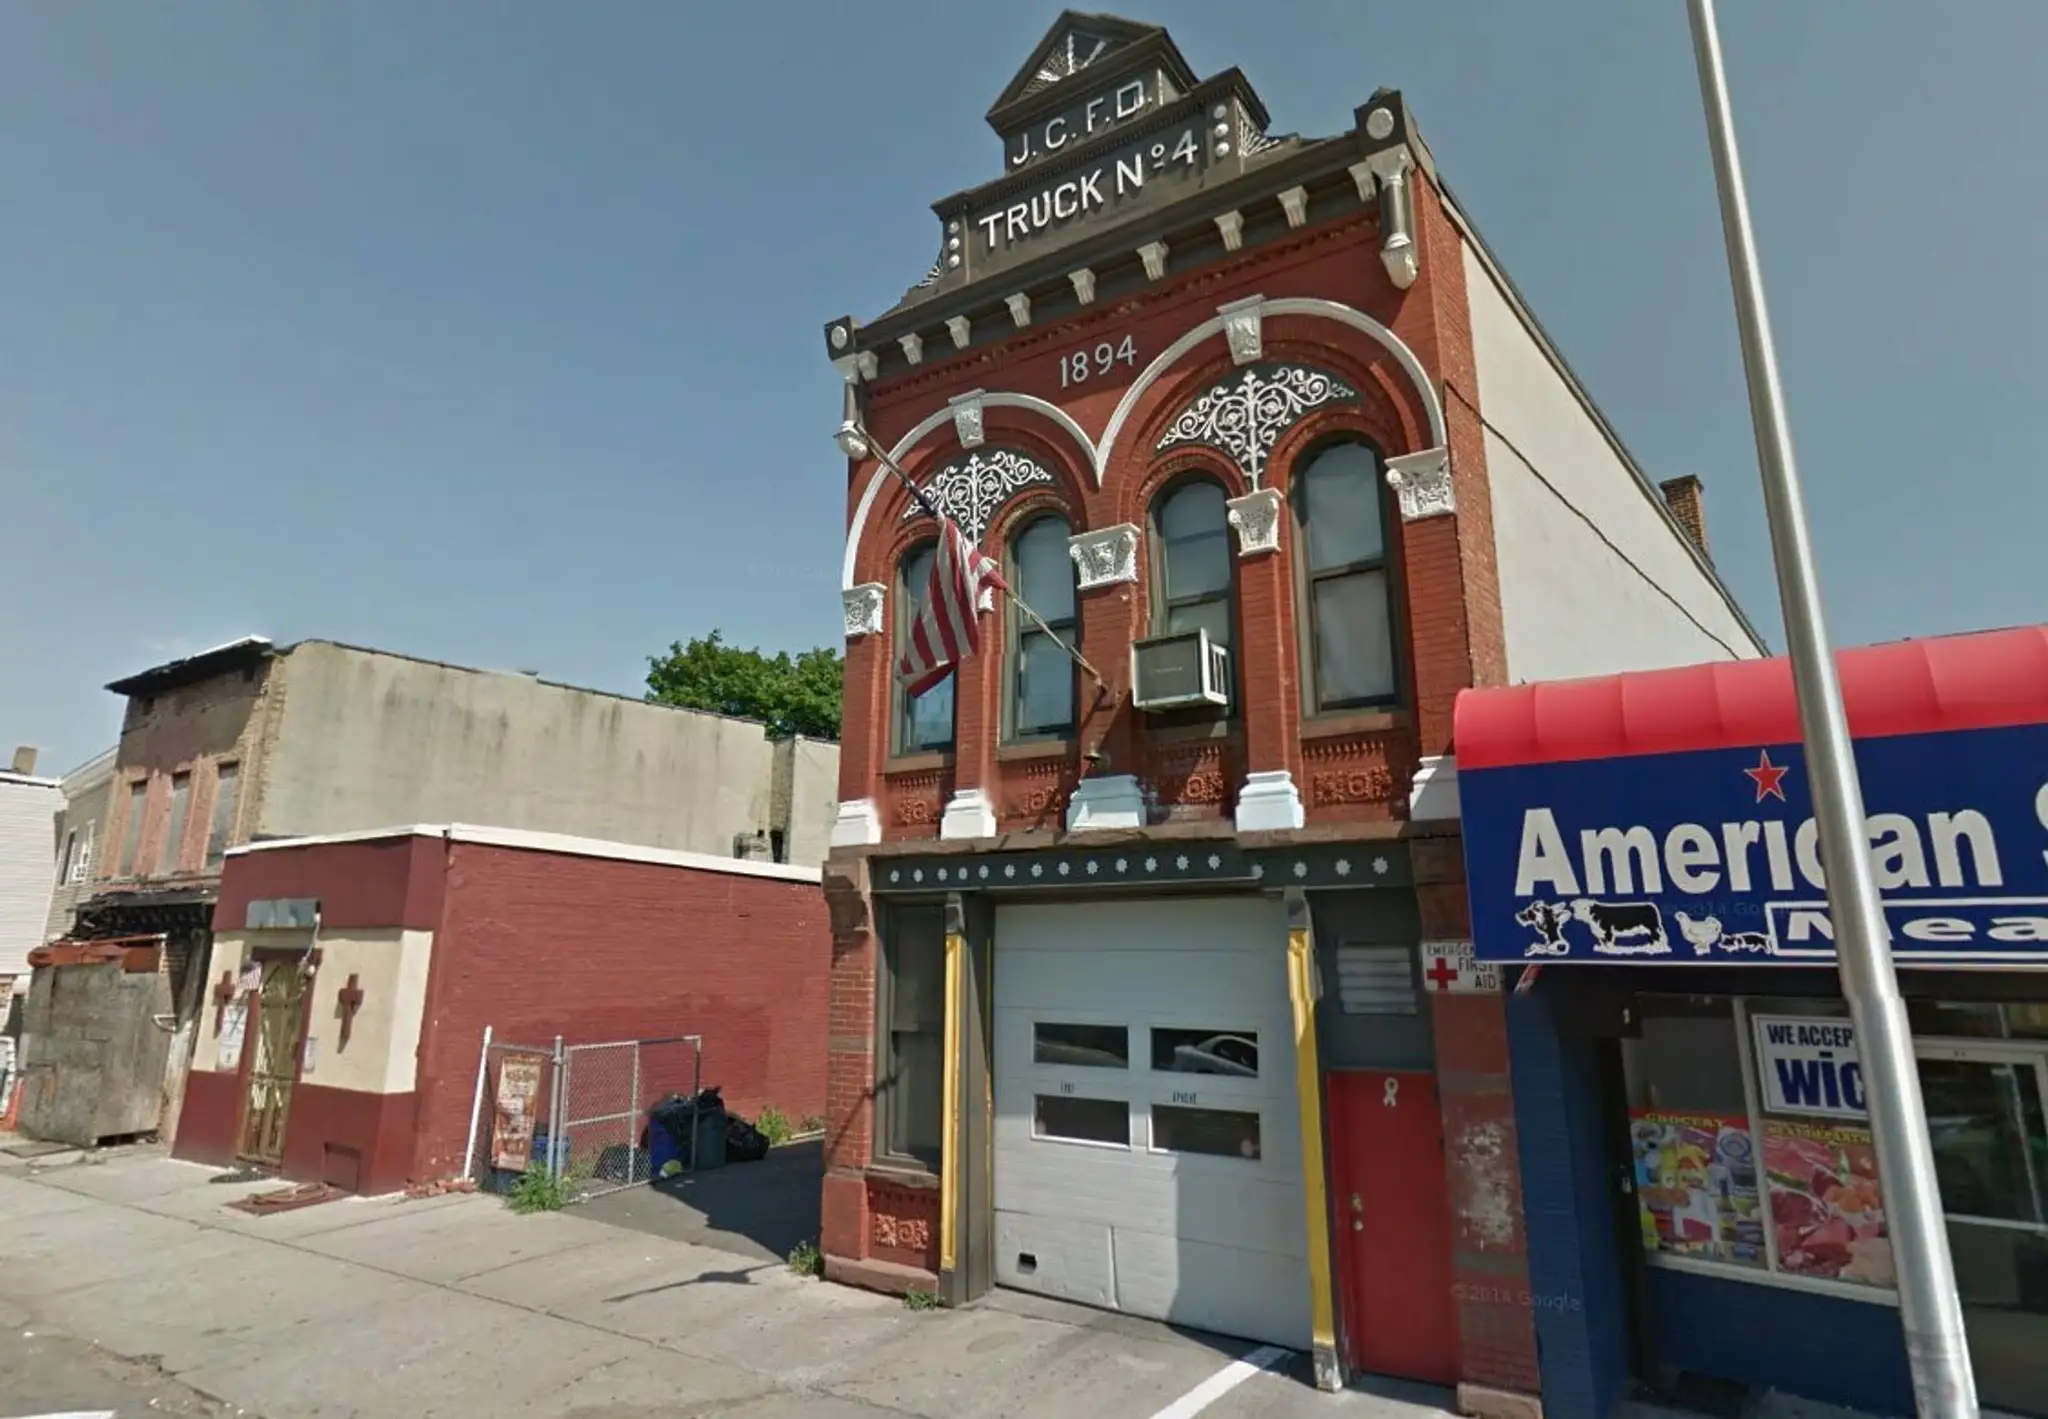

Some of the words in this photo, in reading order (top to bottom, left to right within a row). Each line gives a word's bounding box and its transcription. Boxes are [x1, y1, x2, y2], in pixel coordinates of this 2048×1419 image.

[979, 168, 1103, 247] TRUCK
[1060, 334, 1137, 388] 1894
[1474, 973, 1497, 989] AID
[1766, 1023, 1796, 1045] WE
